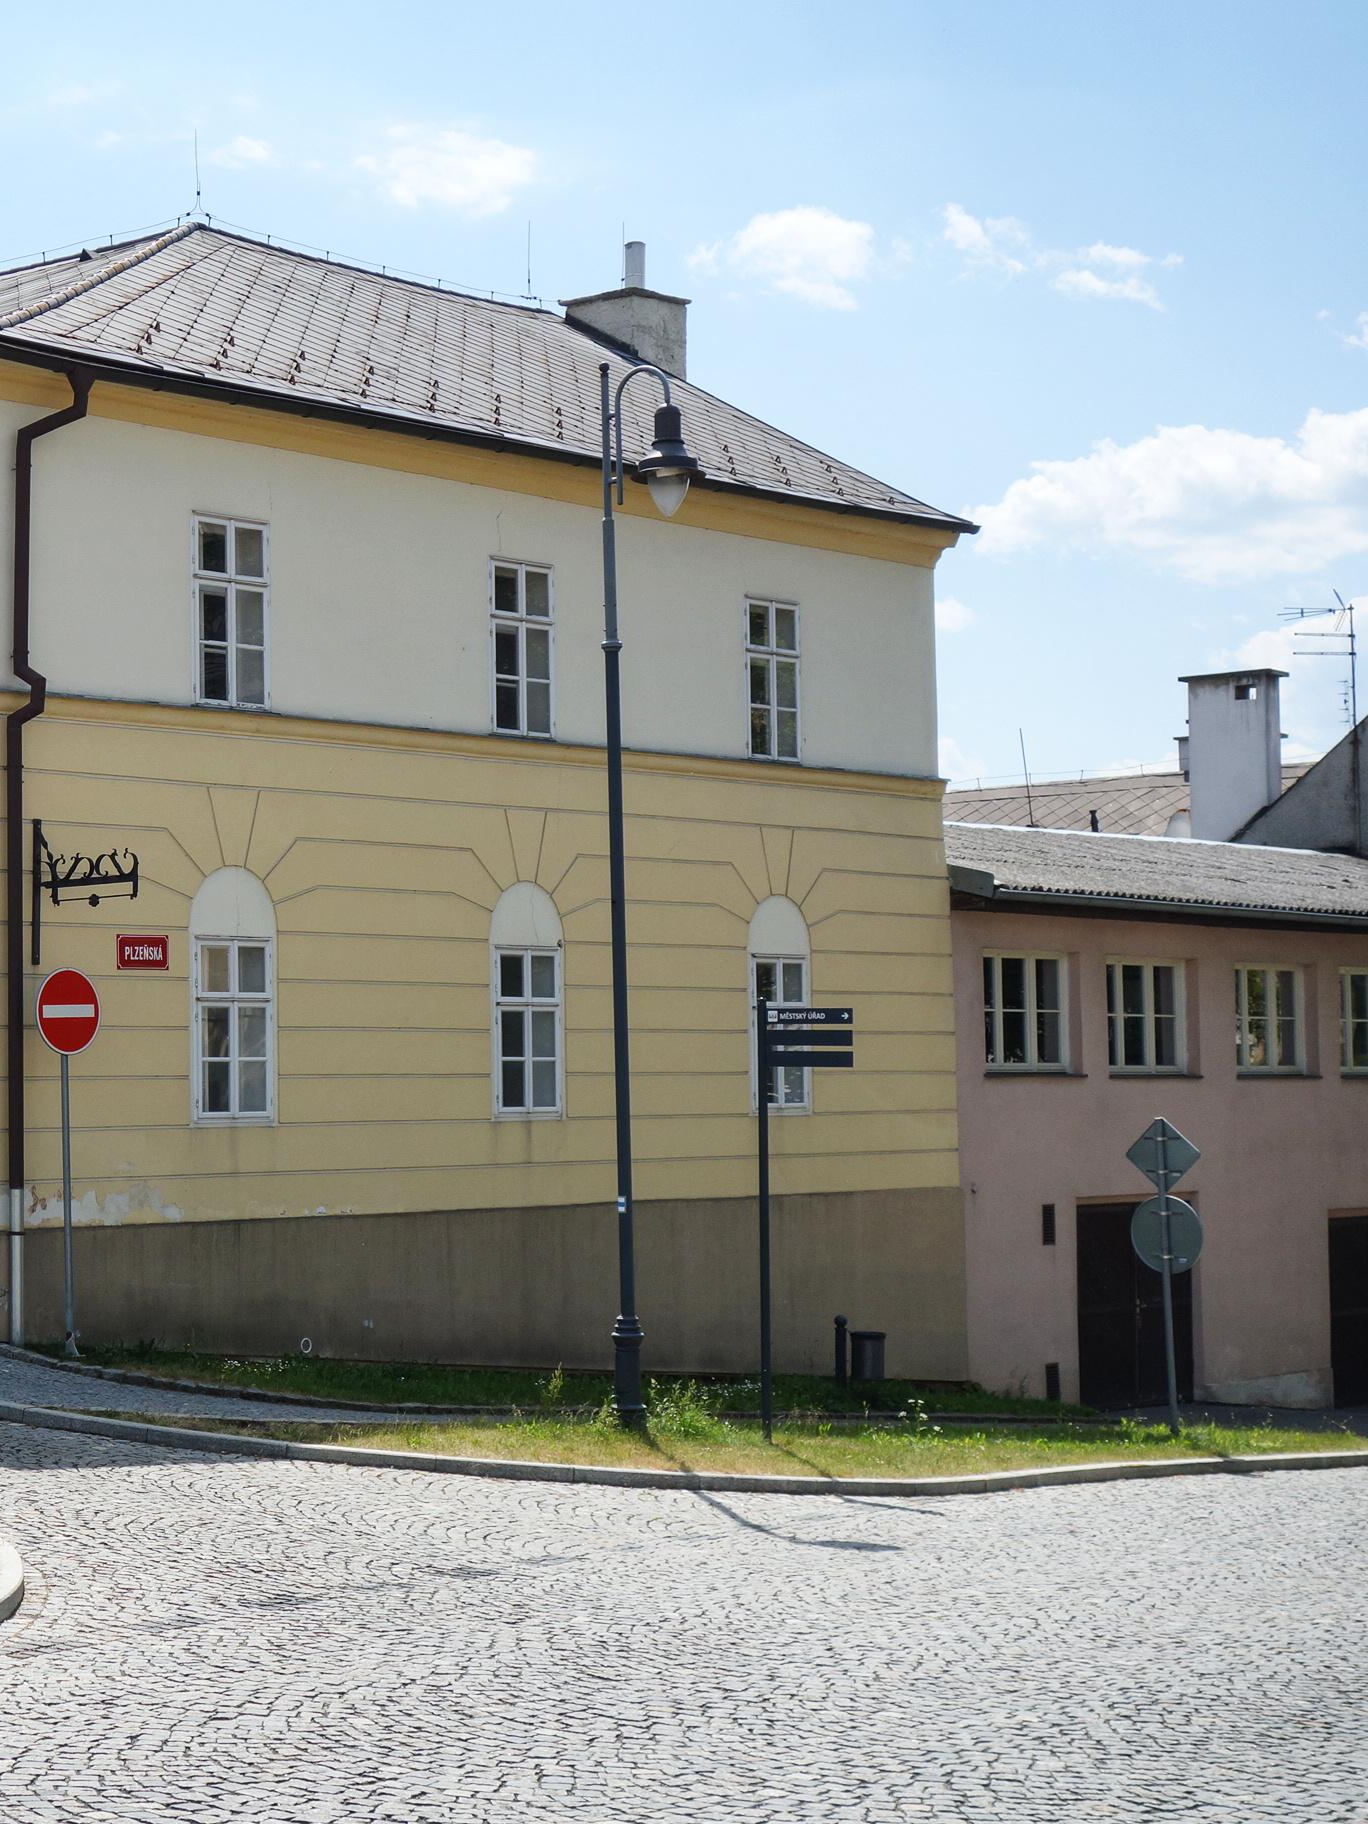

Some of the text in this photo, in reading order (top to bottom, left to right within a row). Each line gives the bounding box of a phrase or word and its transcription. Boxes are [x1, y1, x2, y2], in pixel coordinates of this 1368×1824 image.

[124, 945, 162, 960] PLZEŇSKÁ
[779, 1011, 826, 1020] MĚSTSKÝ ÚŘAD
